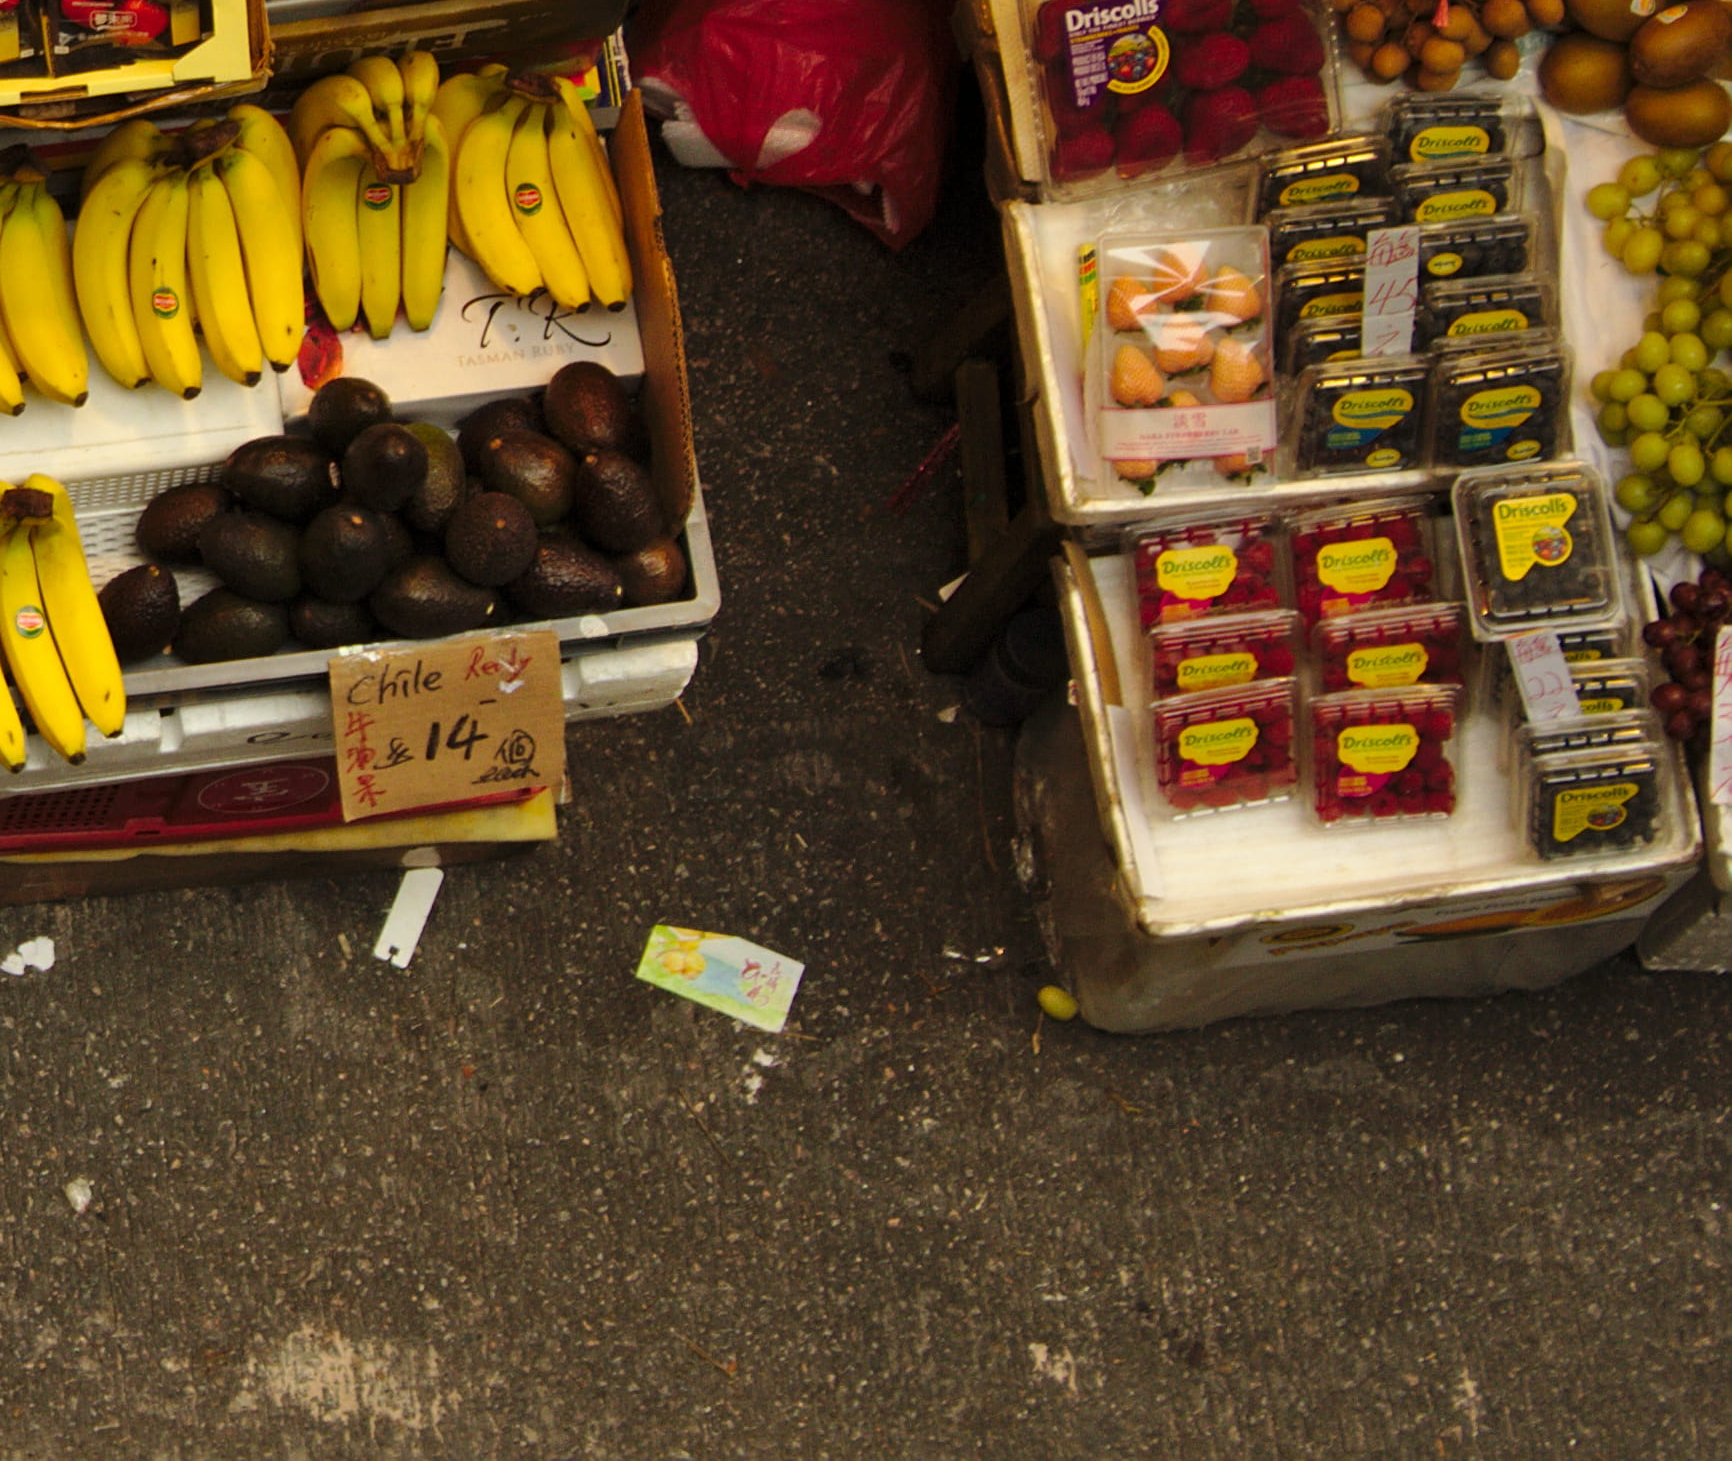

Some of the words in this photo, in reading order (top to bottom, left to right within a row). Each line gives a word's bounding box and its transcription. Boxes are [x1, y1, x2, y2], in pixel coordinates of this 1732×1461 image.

[457, 349, 526, 367] TASMAN
[1340, 397, 1406, 411] Driscoll's
[1467, 395, 1534, 413] Driscoll's
[1497, 496, 1569, 520] Driscoll's
[1162, 554, 1233, 575] Driscoll's
[1320, 549, 1391, 570] Driscoll's
[1181, 660, 1252, 677] Driscoll's
[1351, 651, 1424, 670] Driscoll's
[346, 659, 444, 706] Chile
[1184, 728, 1255, 748] Driscoll's
[1342, 734, 1413, 750] Driscoll's
